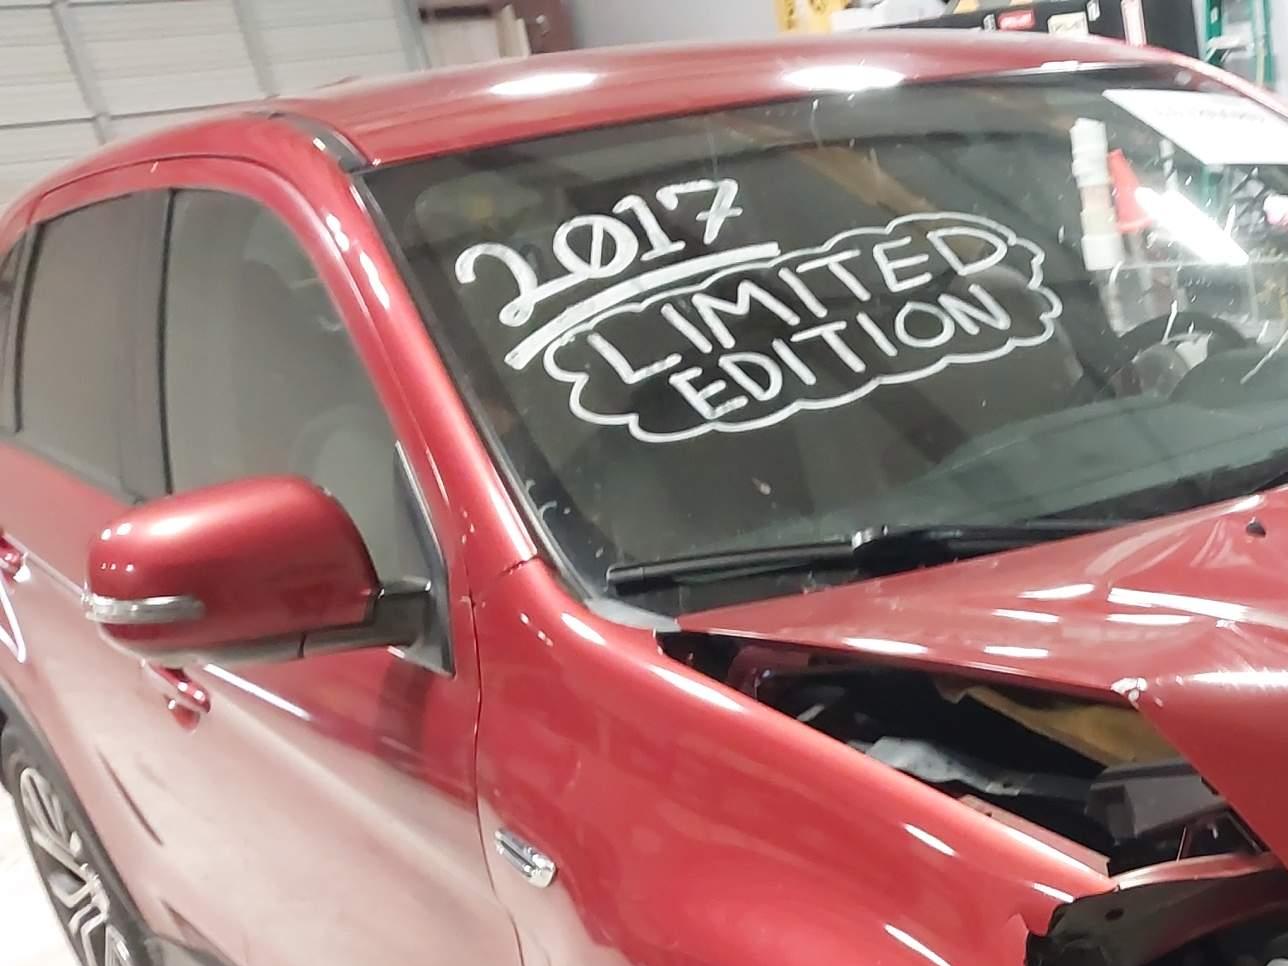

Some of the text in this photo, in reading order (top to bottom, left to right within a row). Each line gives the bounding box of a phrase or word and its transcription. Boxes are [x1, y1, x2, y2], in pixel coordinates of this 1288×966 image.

[455, 178, 743, 328] 2017
[586, 225, 1009, 386] LIMITED
[668, 282, 1012, 420] EDITION
